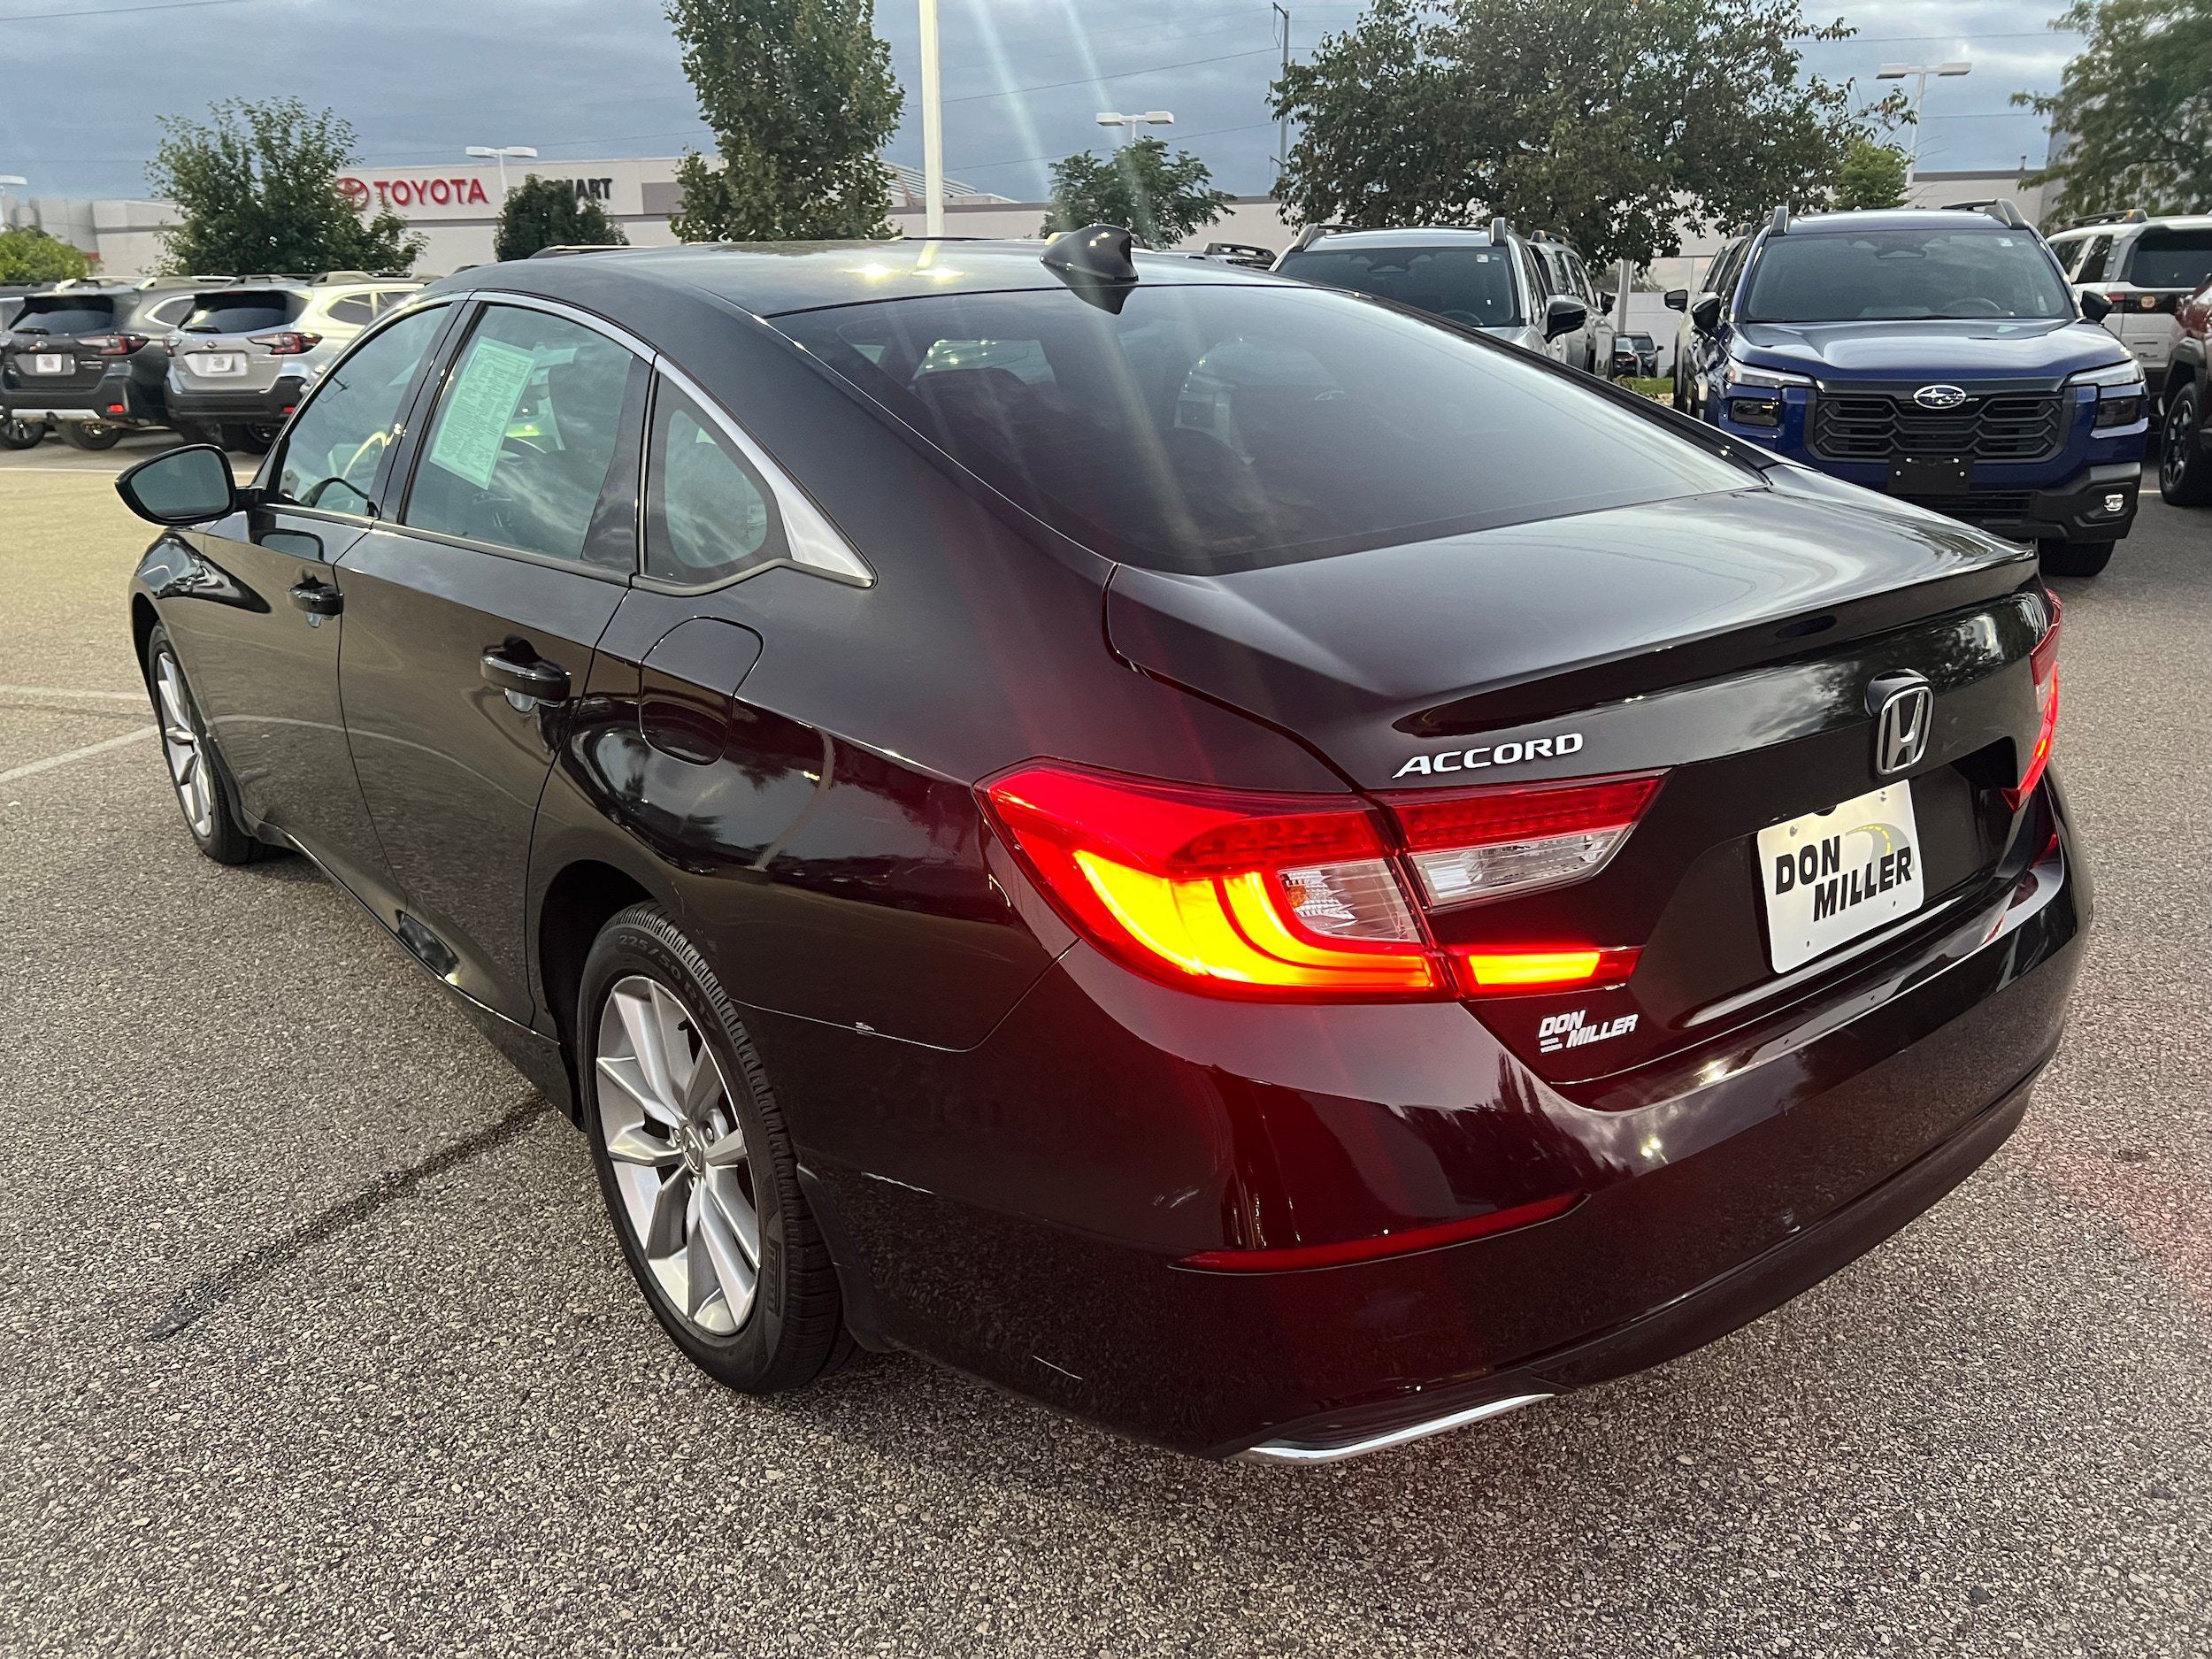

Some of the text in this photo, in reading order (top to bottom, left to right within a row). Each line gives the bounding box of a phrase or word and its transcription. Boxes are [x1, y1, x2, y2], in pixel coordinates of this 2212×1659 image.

[373, 178, 489, 205] TOYOTA
[1392, 733, 1584, 779] ACCORD
[1775, 834, 1840, 895] DON
[1813, 846, 1912, 923] MILLER
[1538, 1010, 1586, 1038] DON
[1565, 1013, 1639, 1048] MILLER
